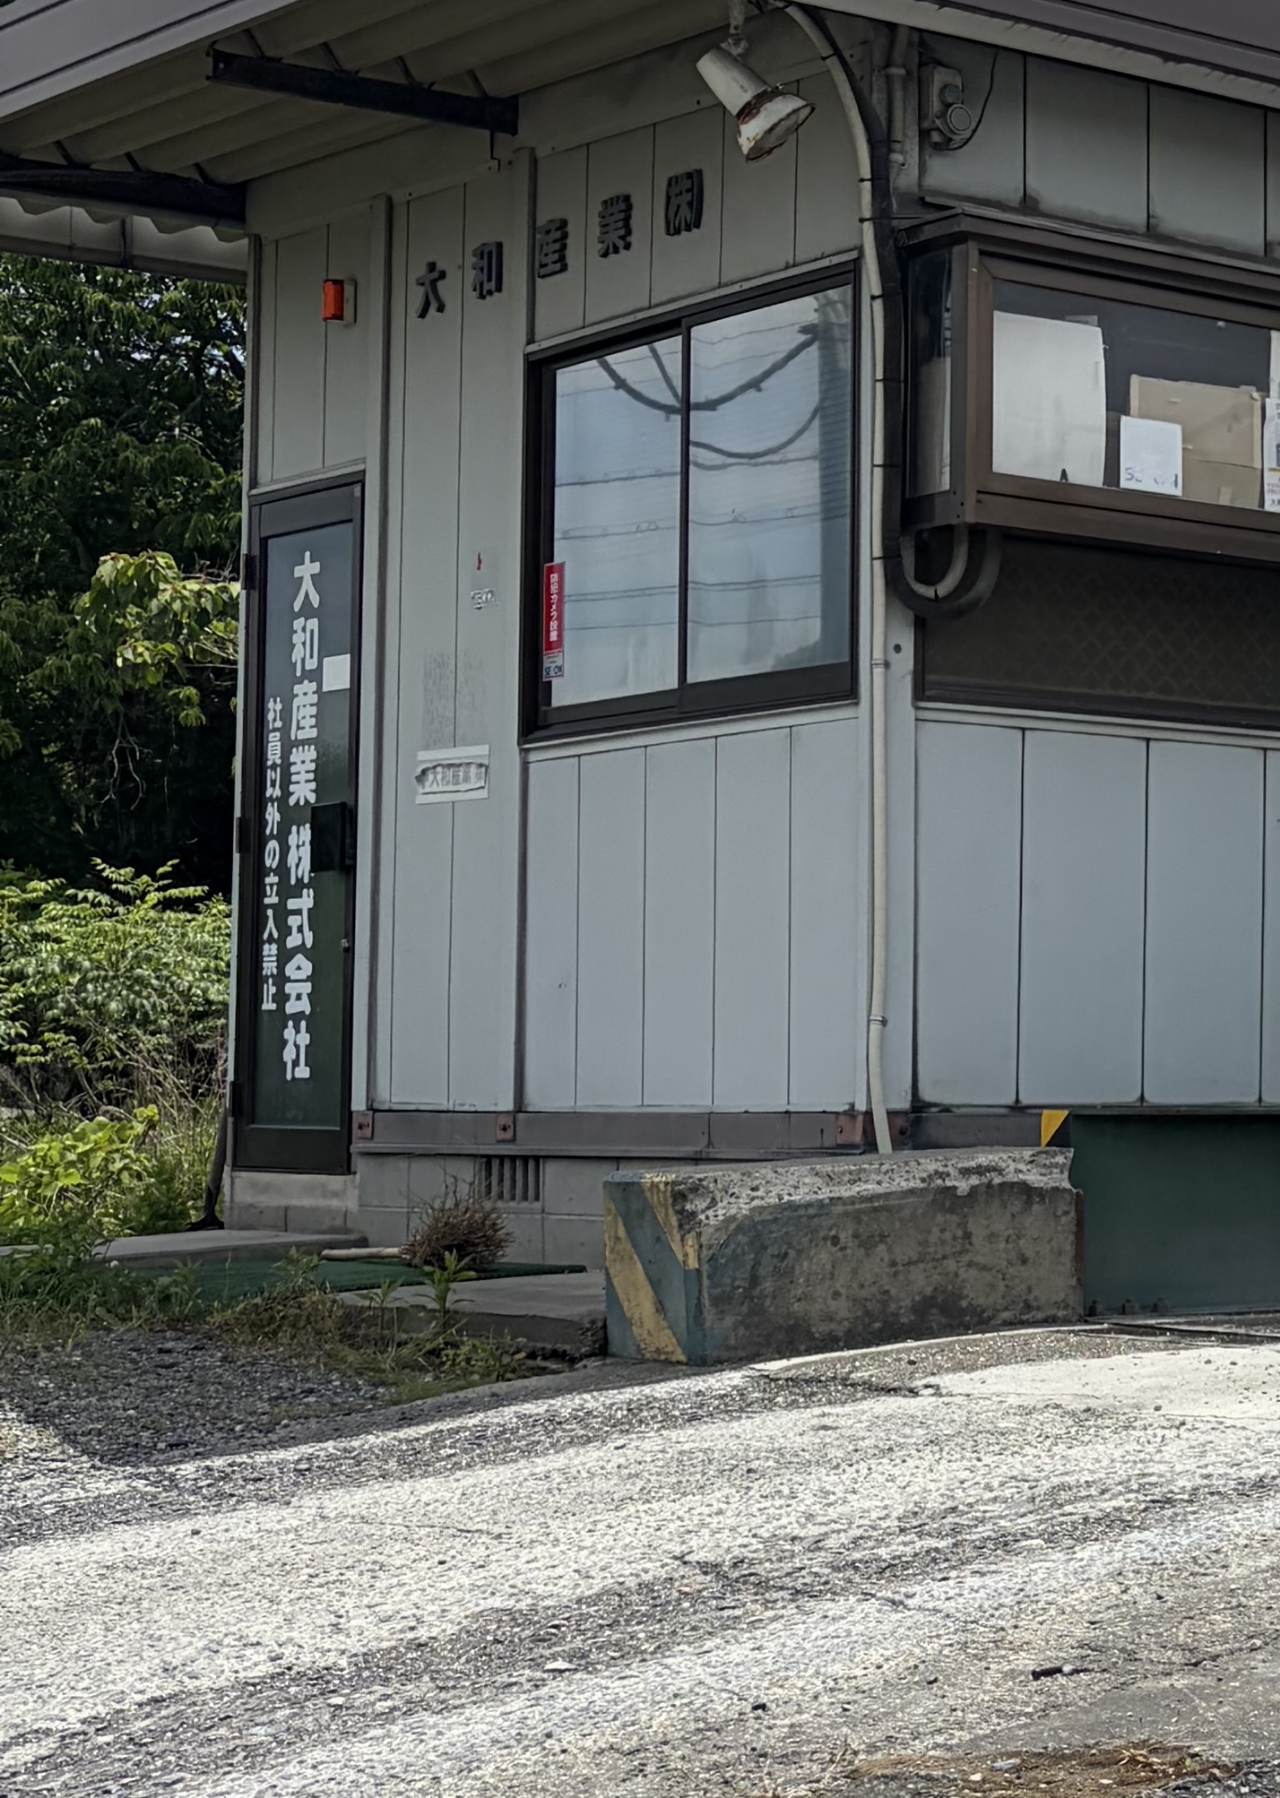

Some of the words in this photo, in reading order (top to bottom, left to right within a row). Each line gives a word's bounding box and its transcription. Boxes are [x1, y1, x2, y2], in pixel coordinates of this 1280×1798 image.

[260, 696, 283, 1012] 社員以外の立入禁止
[283, 550, 321, 1082] 大和産業株式会社
